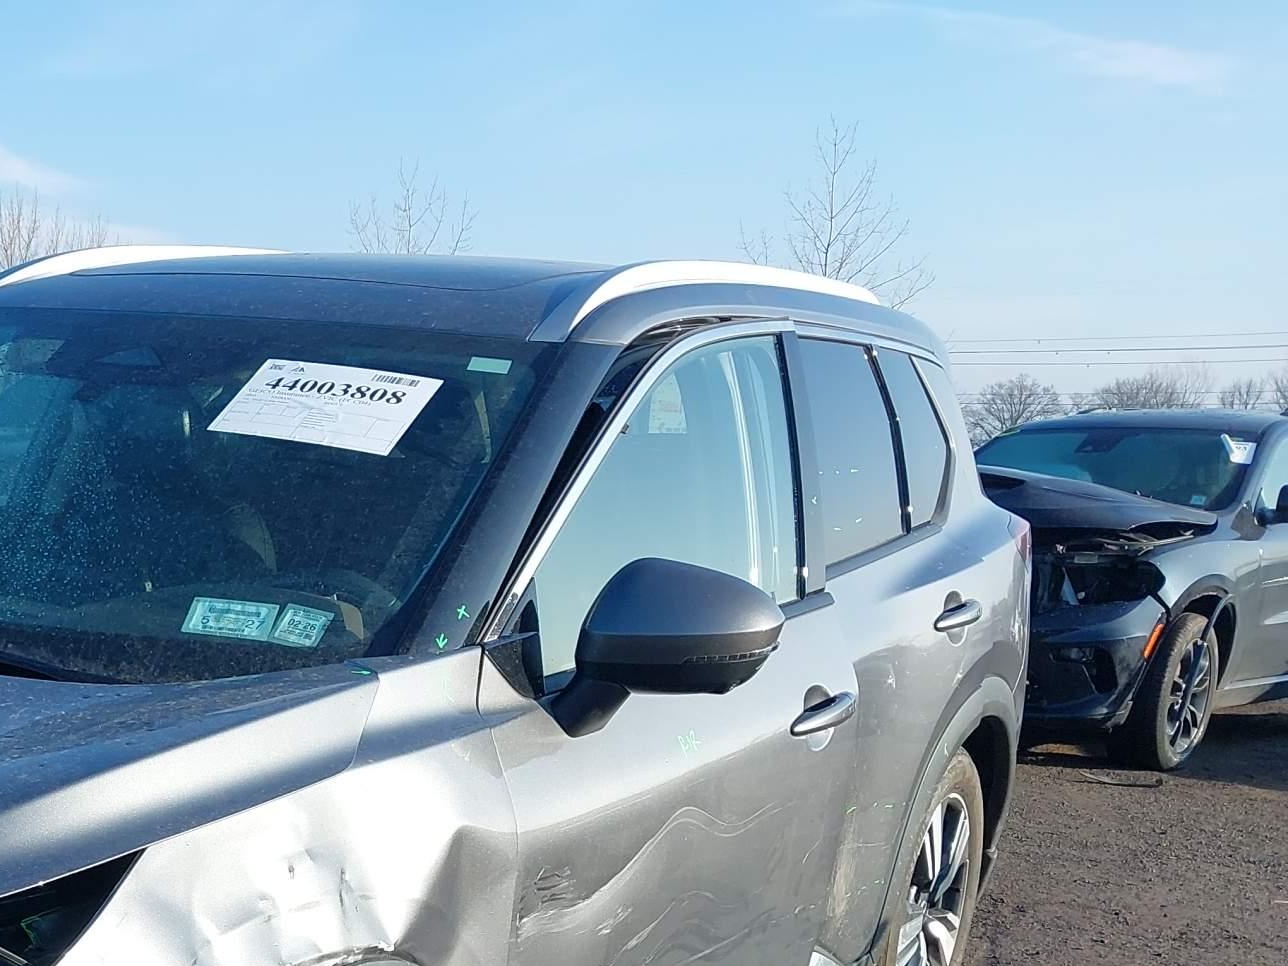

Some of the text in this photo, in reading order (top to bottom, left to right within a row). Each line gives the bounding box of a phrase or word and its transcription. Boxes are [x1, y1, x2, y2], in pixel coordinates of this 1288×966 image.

[264, 376, 407, 405] 44003808
[201, 615, 210, 625] 5
[245, 618, 265, 630] 27
